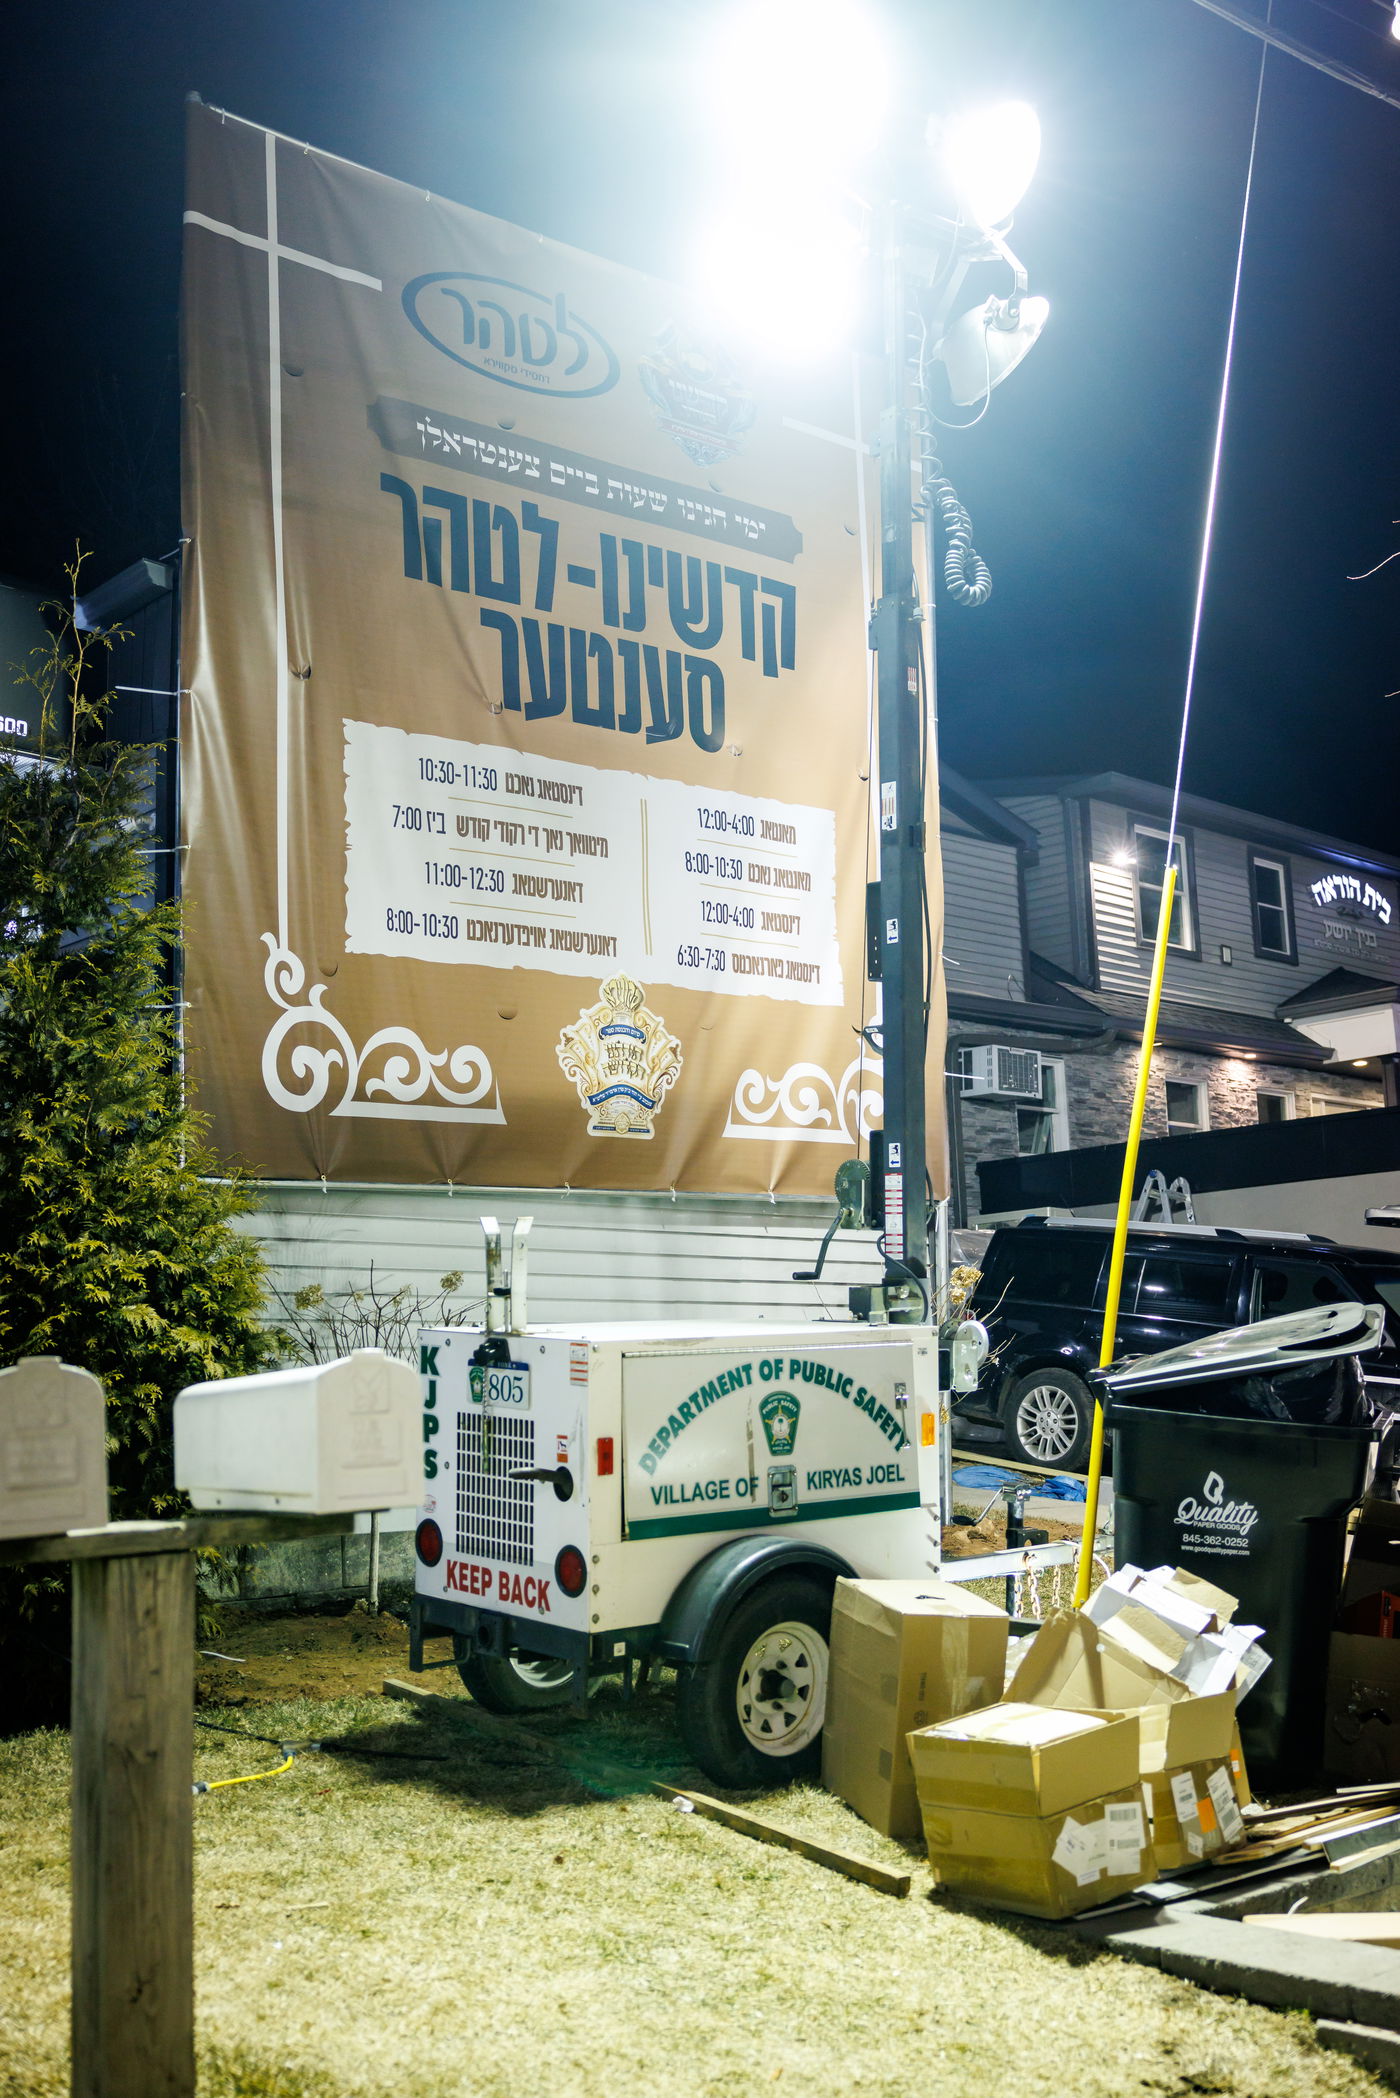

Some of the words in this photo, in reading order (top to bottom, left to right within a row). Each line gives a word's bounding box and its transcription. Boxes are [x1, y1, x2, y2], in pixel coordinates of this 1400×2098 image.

[441, 293, 589, 376] לטהר
[416, 415, 540, 478] צענטראלן
[550, 460, 599, 495] ביים
[607, 478, 667, 512] שעות
[735, 513, 766, 539] ימי
[480, 607, 725, 753] סענטער
[418, 757, 498, 791] 10:30-11:30
[505, 772, 535, 797] נאכט
[537, 778, 583, 806] דינסטאג
[392, 804, 422, 831] 7:00
[427, 810, 446, 835] ביז
[456, 815, 490, 842] קודש
[697, 808, 755, 836] 12:00-4:00
[528, 825, 539, 847] די
[542, 827, 564, 853] נאך
[566, 831, 609, 858] מיטוואך
[760, 820, 796, 845] מאנטאג
[424, 861, 505, 893] 11:00-12:30
[685, 851, 743, 880] 8:00-10:30
[748, 862, 771, 885] נאכט
[774, 867, 811, 891] מאנטאג
[512, 873, 584, 903] דאנערשטאג
[1311, 874, 1362, 906] הוראה
[701, 900, 755, 929] 12:00-4:00
[1362, 883, 1392, 925] בית
[386, 908, 459, 939] 8:00-10:30
[466, 918, 547, 949] אויפדערנאכט
[761, 911, 800, 935] דינסטאג
[549, 928, 617, 957] דאנערשטאג
[677, 944, 726, 972] 6:30-7:30
[731, 953, 783, 978] פארנאכטס
[786, 960, 821, 984] דינסטאג
[489, 1374, 524, 1403] 805
[638, 1363, 752, 1475] DEPARTMENT
[759, 1359, 783, 1381] OF
[789, 1359, 854, 1399] PUBLIC
[853, 1387, 907, 1452] SAFETY
[650, 1480, 730, 1505] VILLAGE
[735, 1477, 759, 1497] OF
[806, 1467, 862, 1490] KIRYAS
[867, 1464, 905, 1484] JOEL
[1174, 1497, 1258, 1535] Quality
[1193, 1521, 1215, 1529] PAPER
[1216, 1523, 1240, 1531] GOODS
[1183, 1533, 1248, 1548] 845-362-0252
[447, 1559, 492, 1596] KEEP
[499, 1570, 551, 1612] BACK
